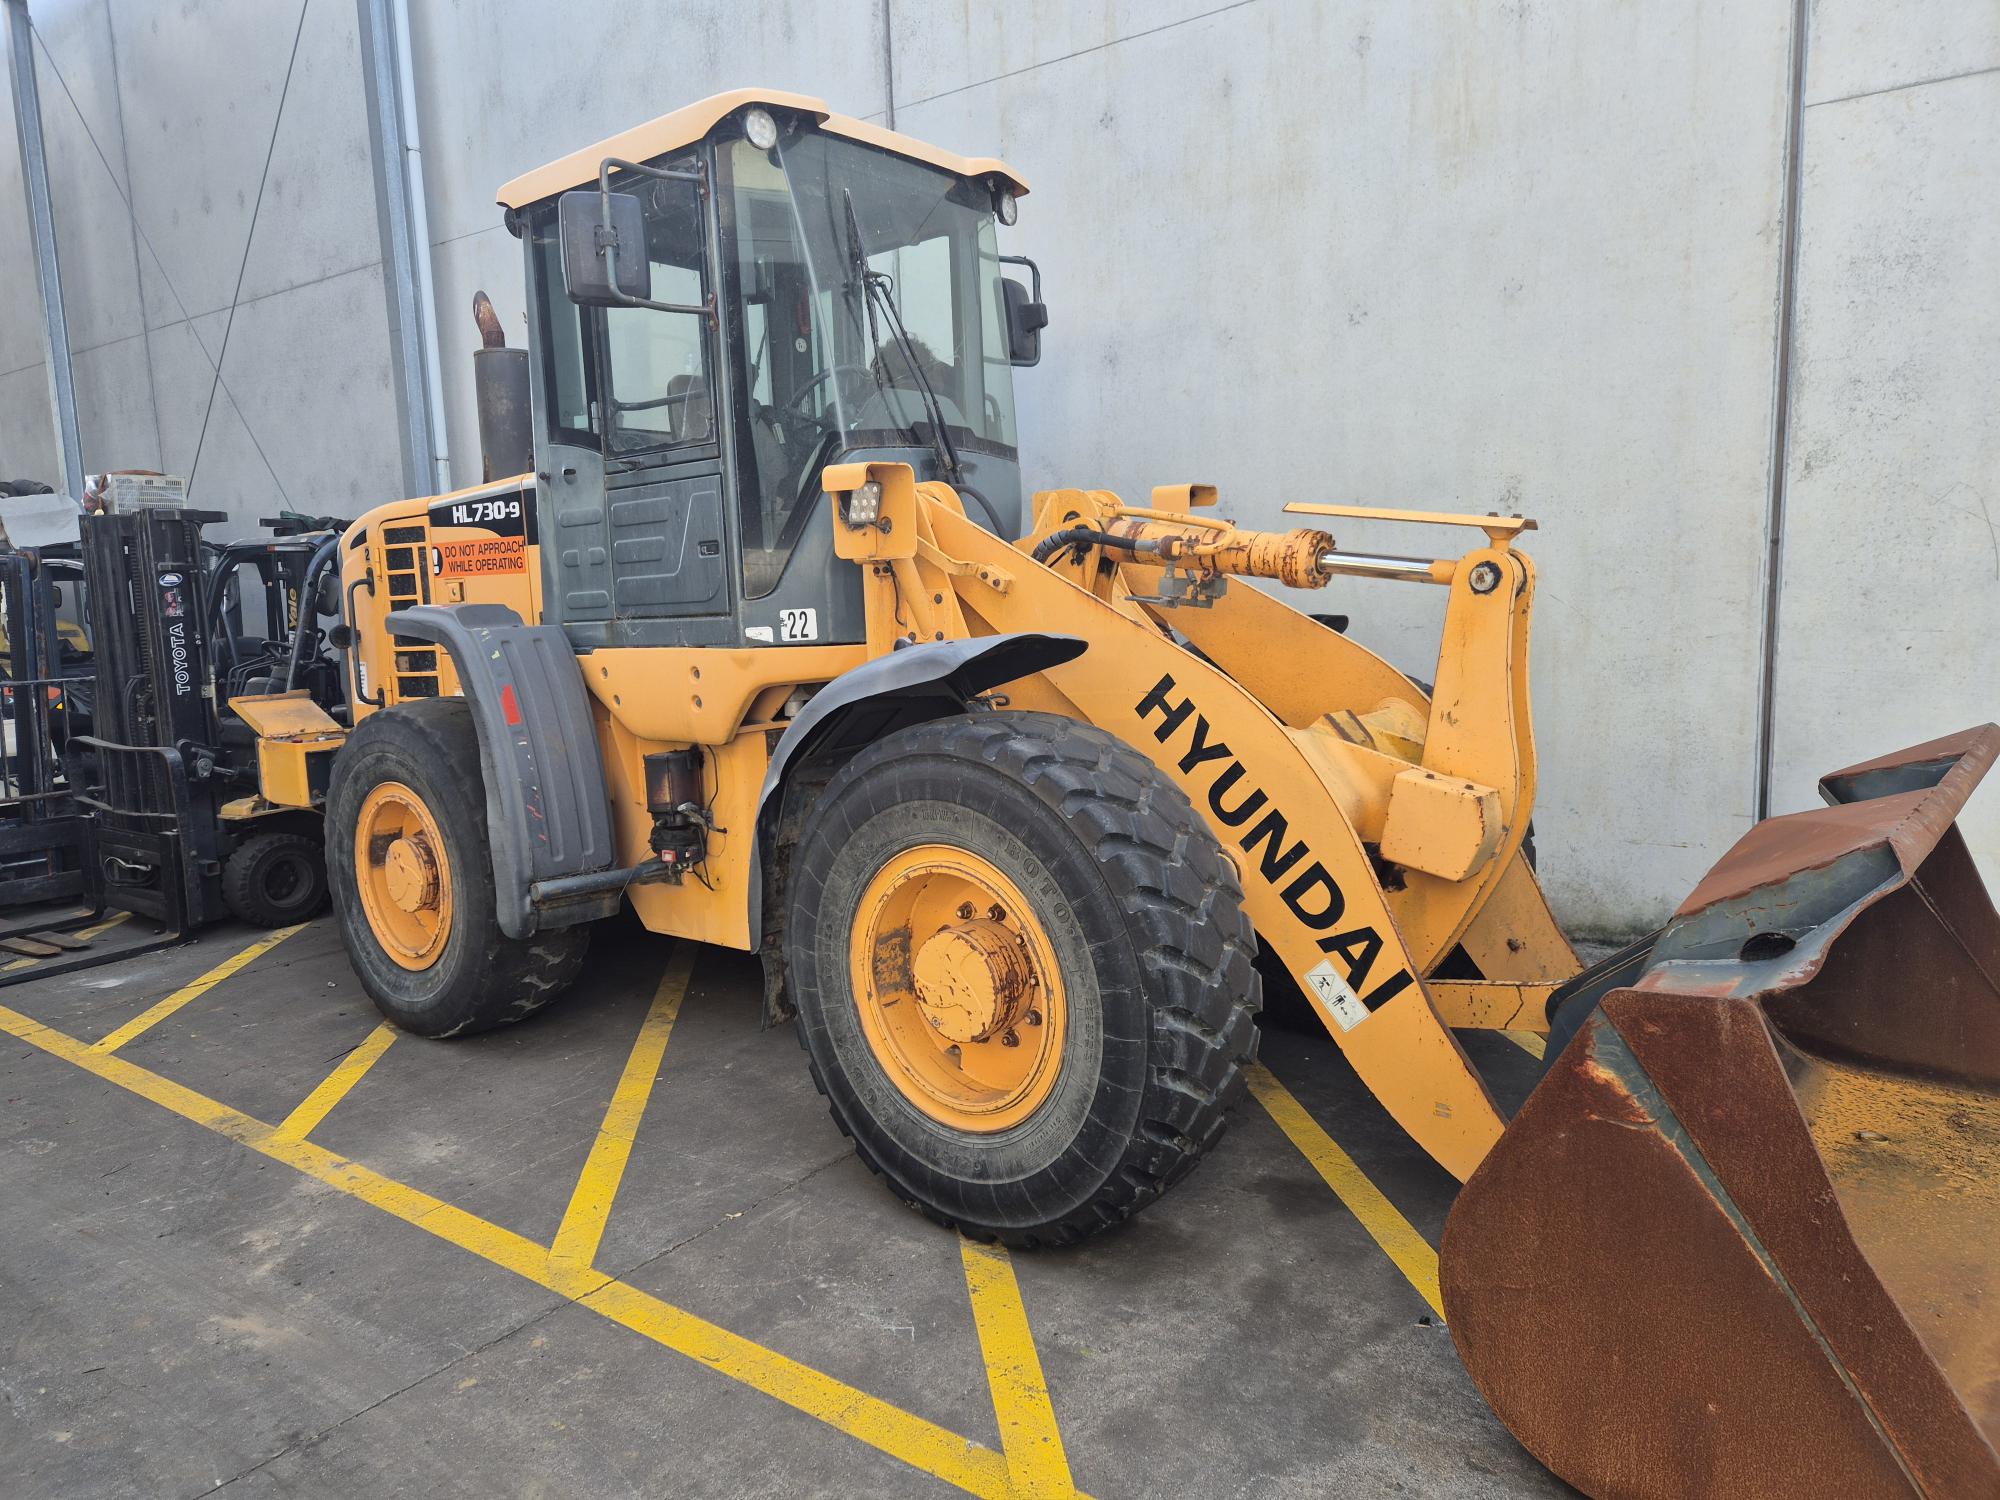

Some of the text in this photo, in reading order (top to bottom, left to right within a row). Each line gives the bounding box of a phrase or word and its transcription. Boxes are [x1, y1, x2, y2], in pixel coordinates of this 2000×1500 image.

[452, 501, 520, 524] HL730-9
[444, 540, 525, 558] DO NOT APPROACH
[448, 556, 524, 573] WHILE OPERATING
[284, 587, 297, 629] Yale
[788, 611, 809, 638] 22
[169, 622, 191, 696] TOYOTA
[1134, 672, 1414, 1014] HYUNDAI
[1004, 838, 1072, 924] BOTO
